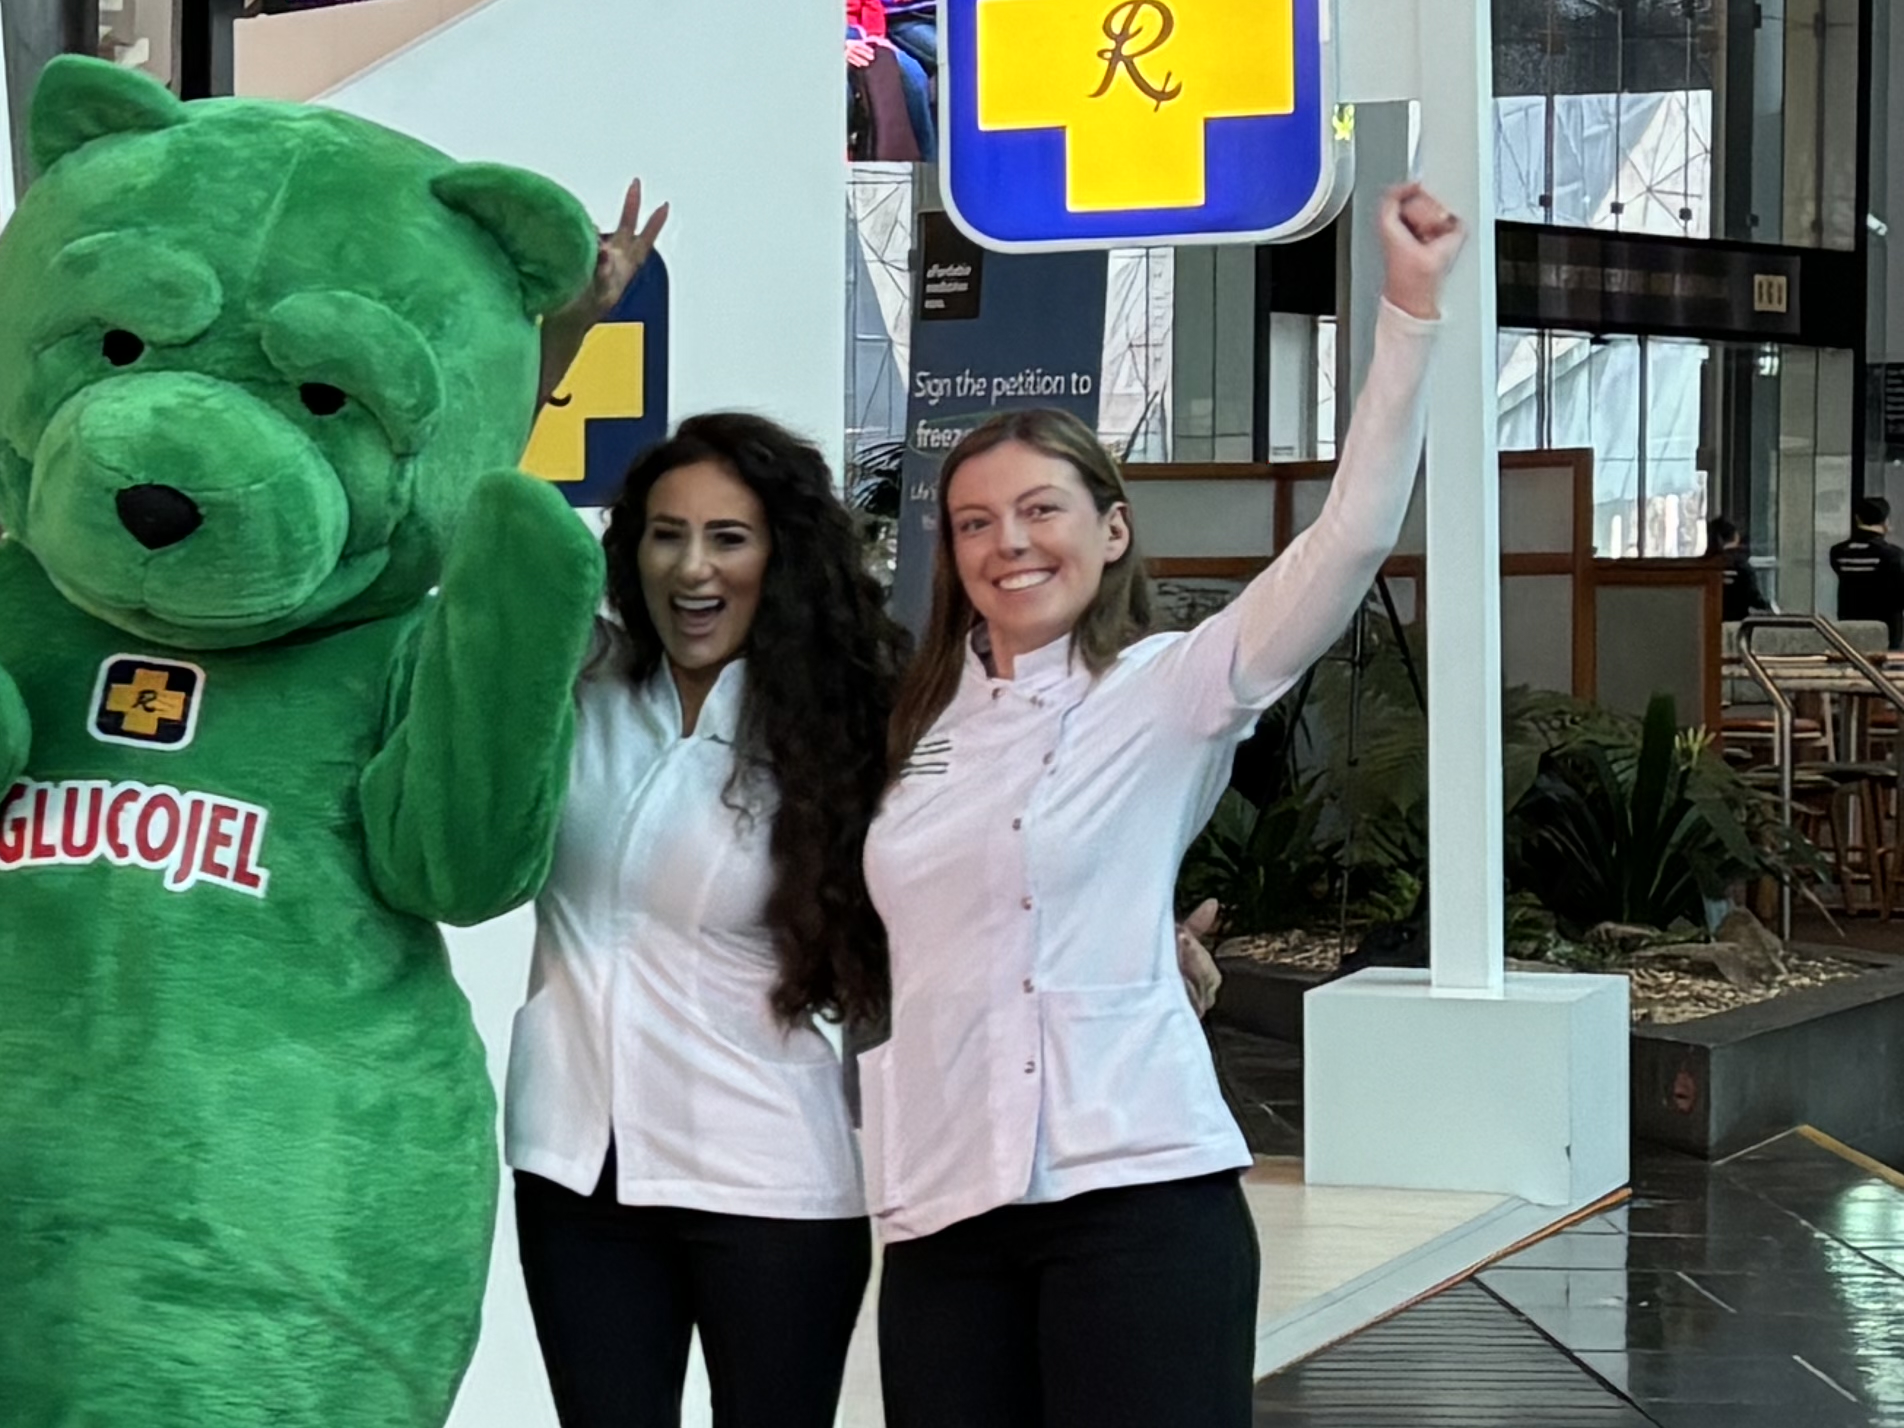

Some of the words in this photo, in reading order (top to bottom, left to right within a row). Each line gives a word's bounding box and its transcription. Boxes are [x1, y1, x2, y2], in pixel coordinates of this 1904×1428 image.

[913, 371, 952, 405] Sign
[955, 369, 988, 398] the
[990, 368, 1065, 407] petition
[1070, 372, 1092, 396] to
